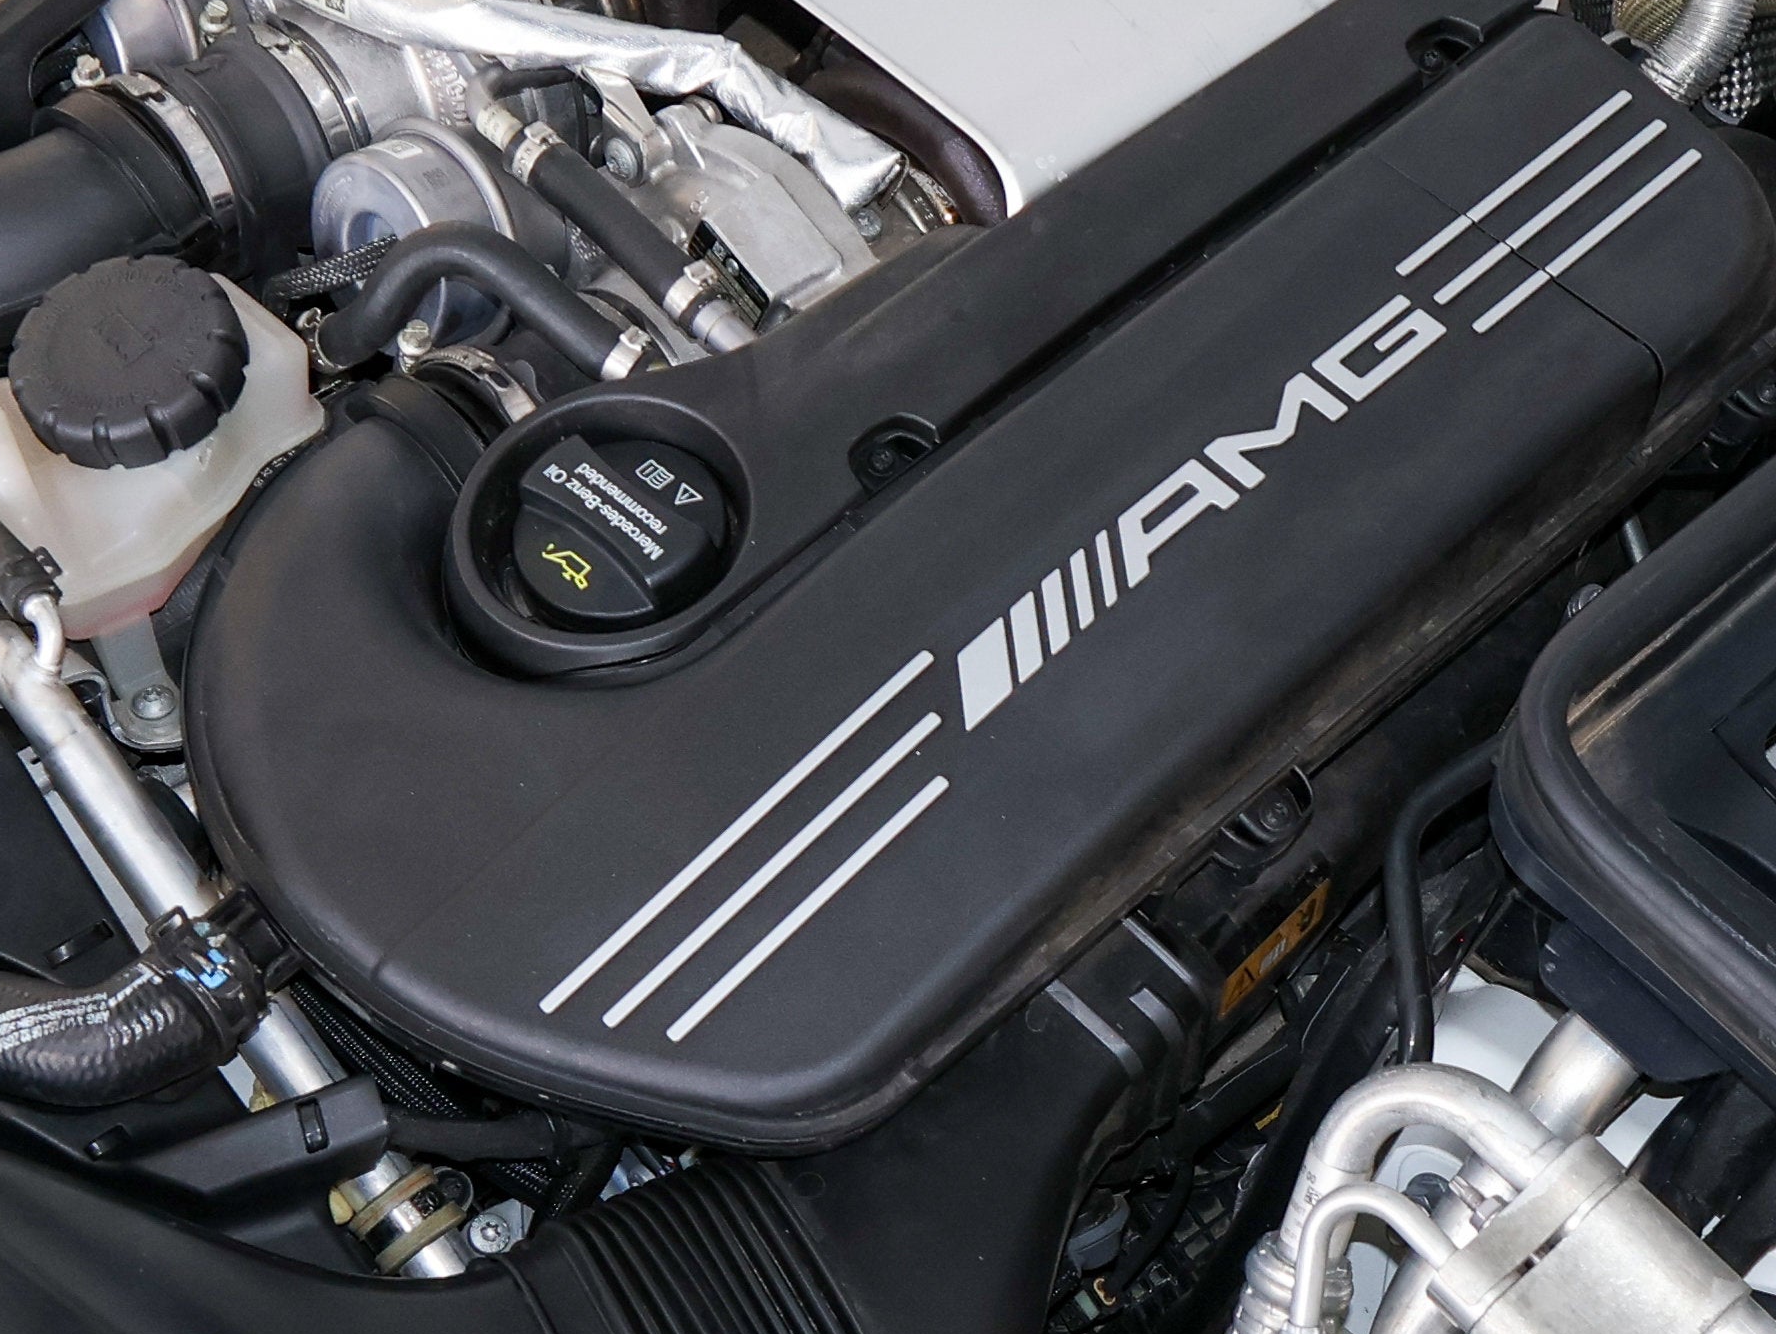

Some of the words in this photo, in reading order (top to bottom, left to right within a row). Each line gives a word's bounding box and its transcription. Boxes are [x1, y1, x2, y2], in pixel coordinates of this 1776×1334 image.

[541, 463, 568, 485] Oil
[1118, 294, 1447, 588] AMG
[565, 477, 665, 561] Mercedes-Benz
[573, 462, 669, 536] recommended
